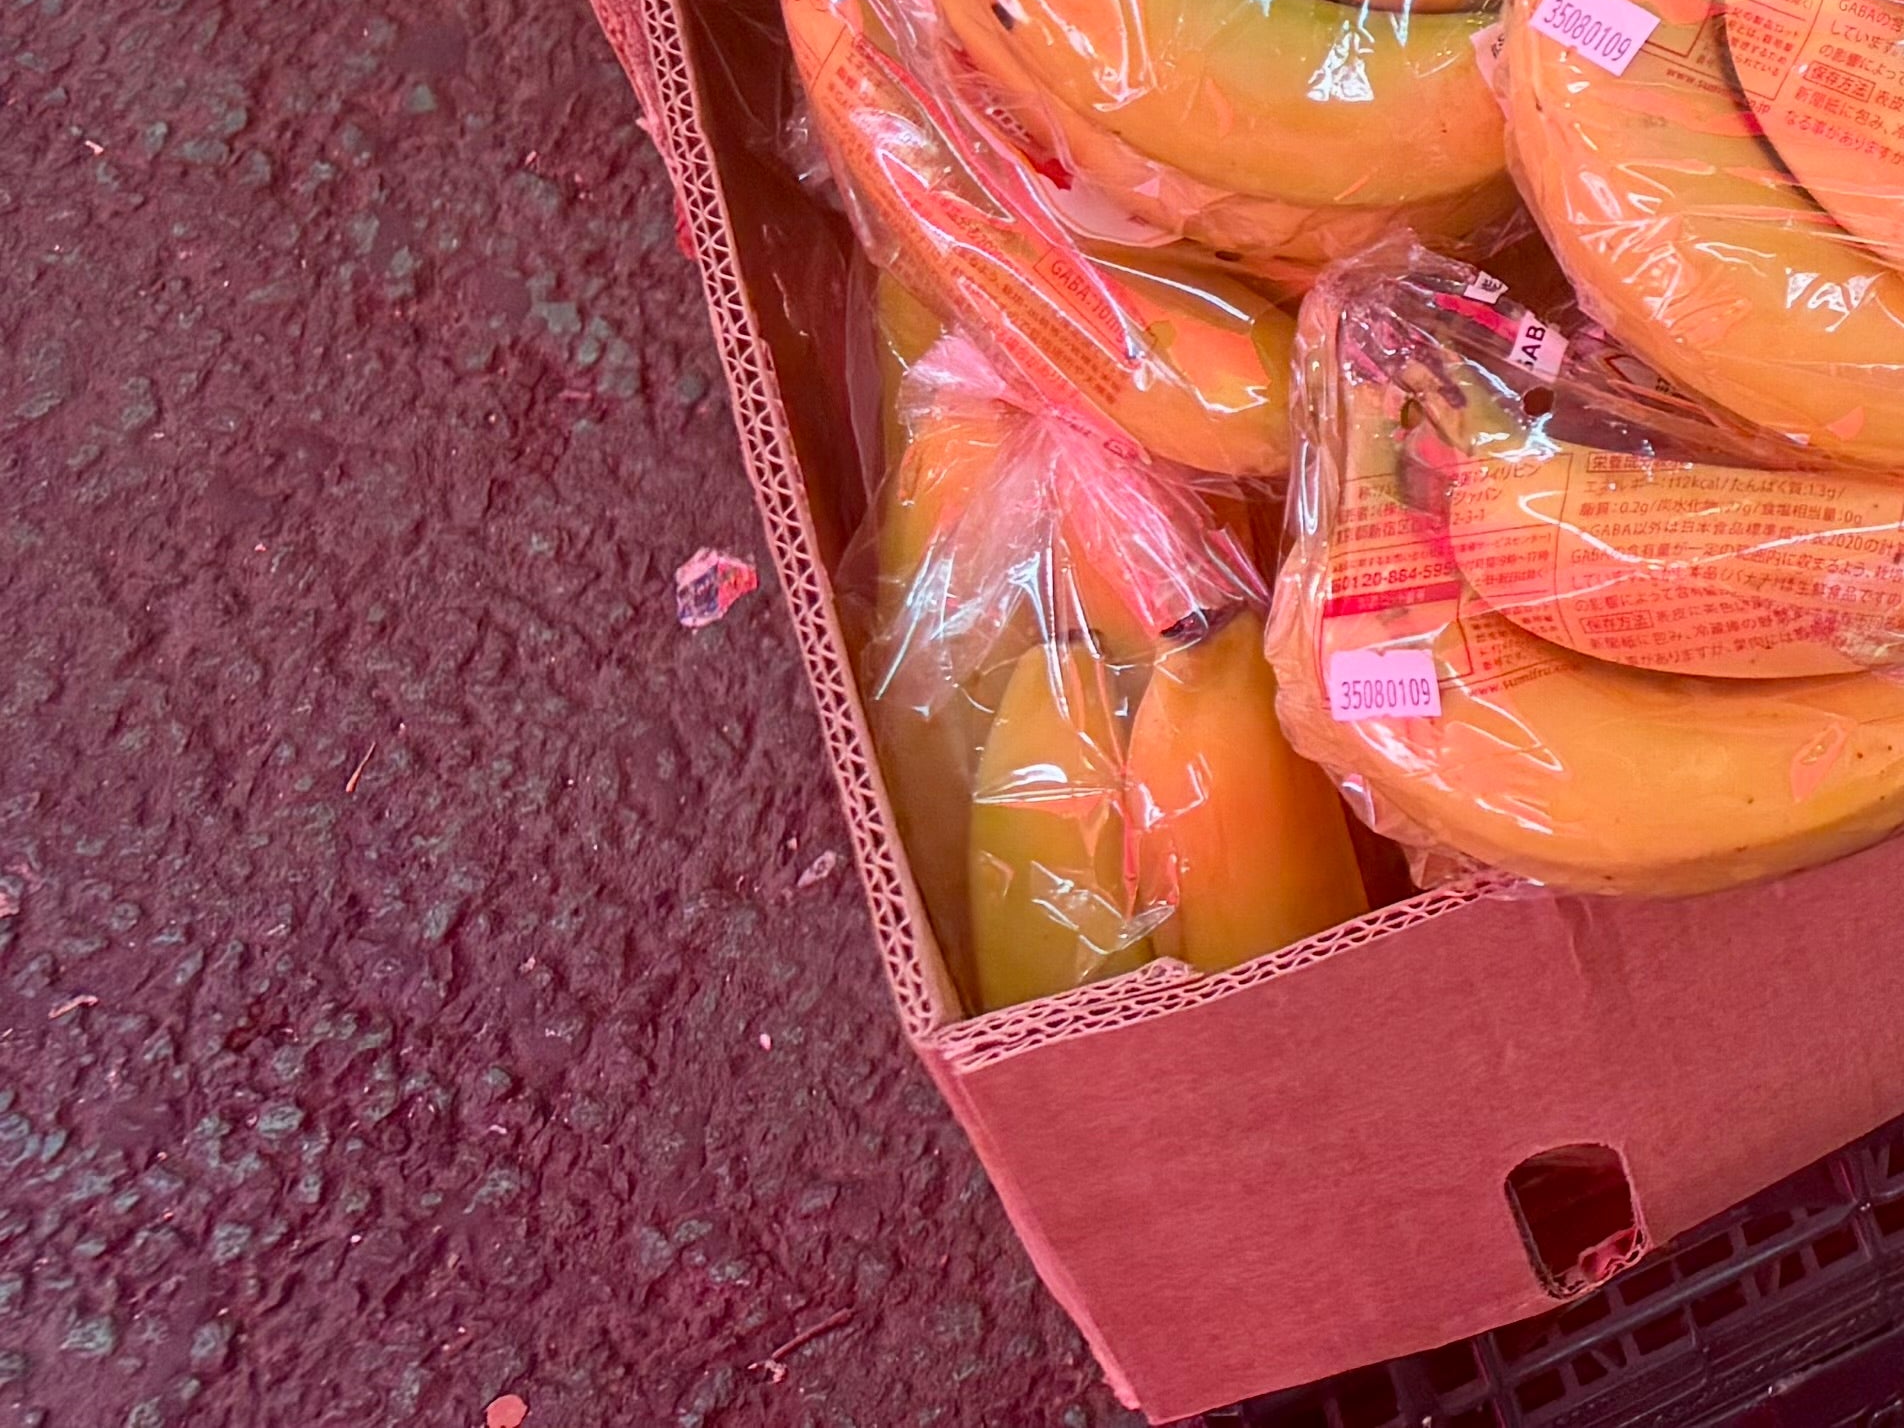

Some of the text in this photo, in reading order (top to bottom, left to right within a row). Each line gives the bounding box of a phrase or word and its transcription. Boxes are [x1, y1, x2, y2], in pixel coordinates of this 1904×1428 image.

[1810, 66, 1873, 99] 保存方法
[1340, 677, 1432, 711] 35080109
